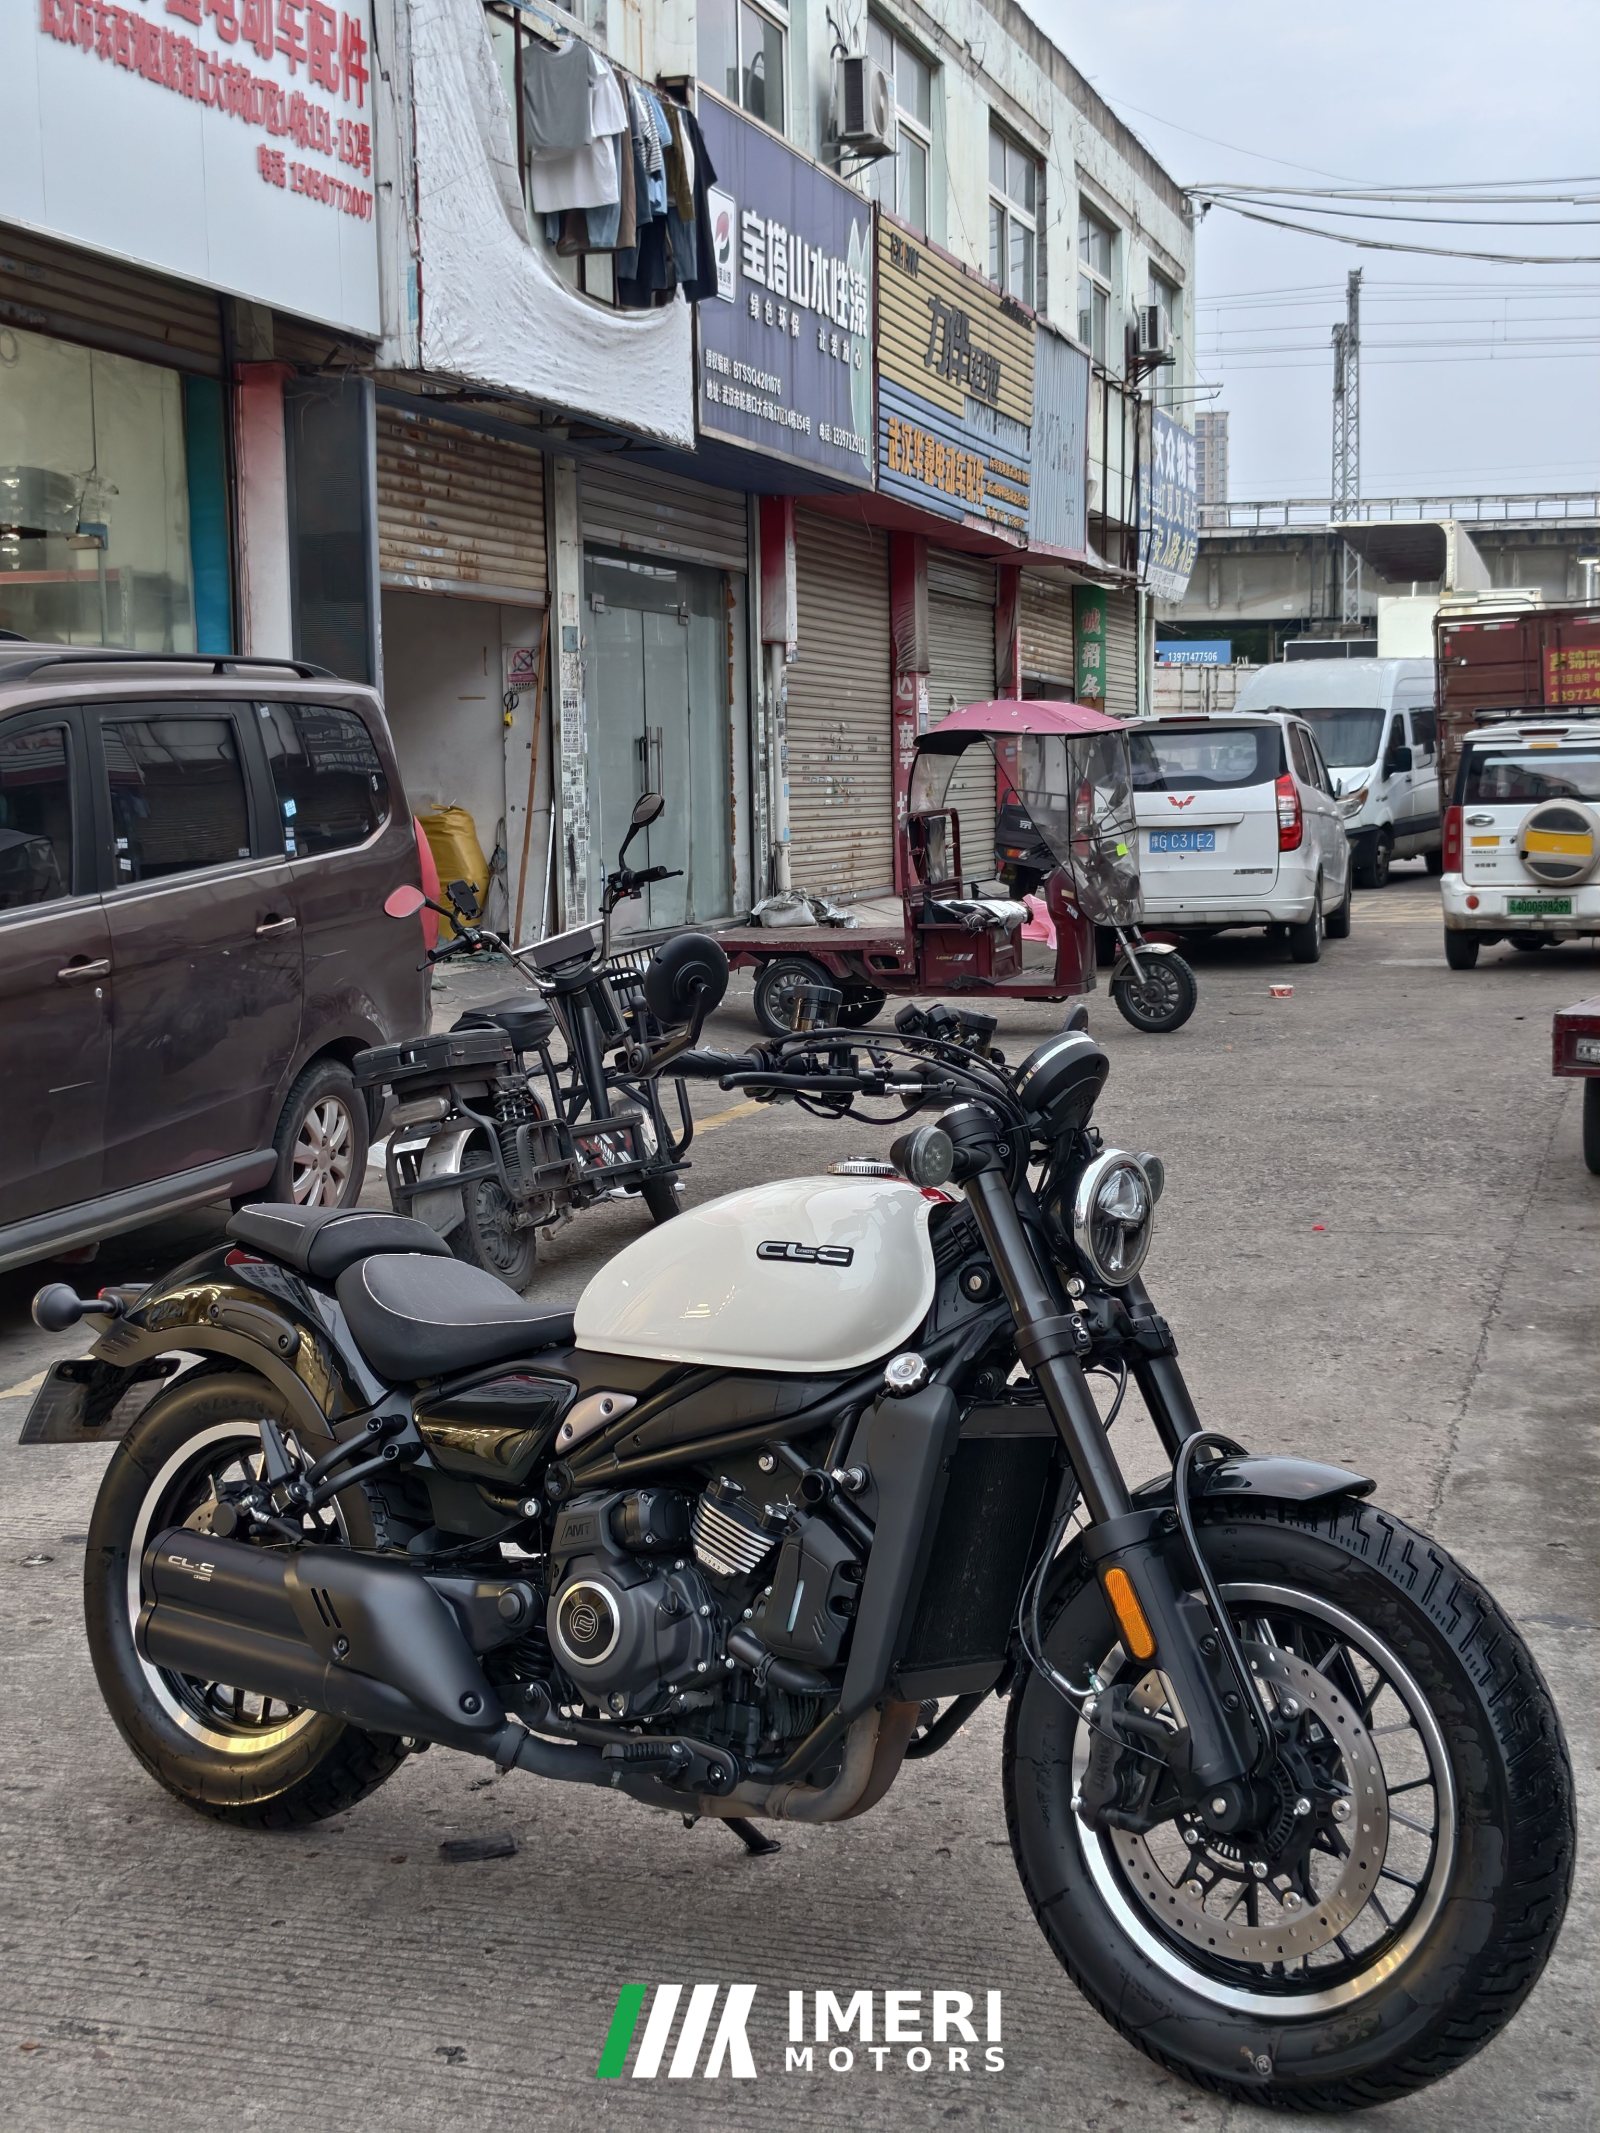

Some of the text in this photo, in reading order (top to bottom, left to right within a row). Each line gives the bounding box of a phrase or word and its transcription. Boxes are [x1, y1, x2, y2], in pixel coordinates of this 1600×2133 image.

[741, 209, 868, 338] 宝塔山水性漆
[750, 292, 800, 339] 绿色环保
